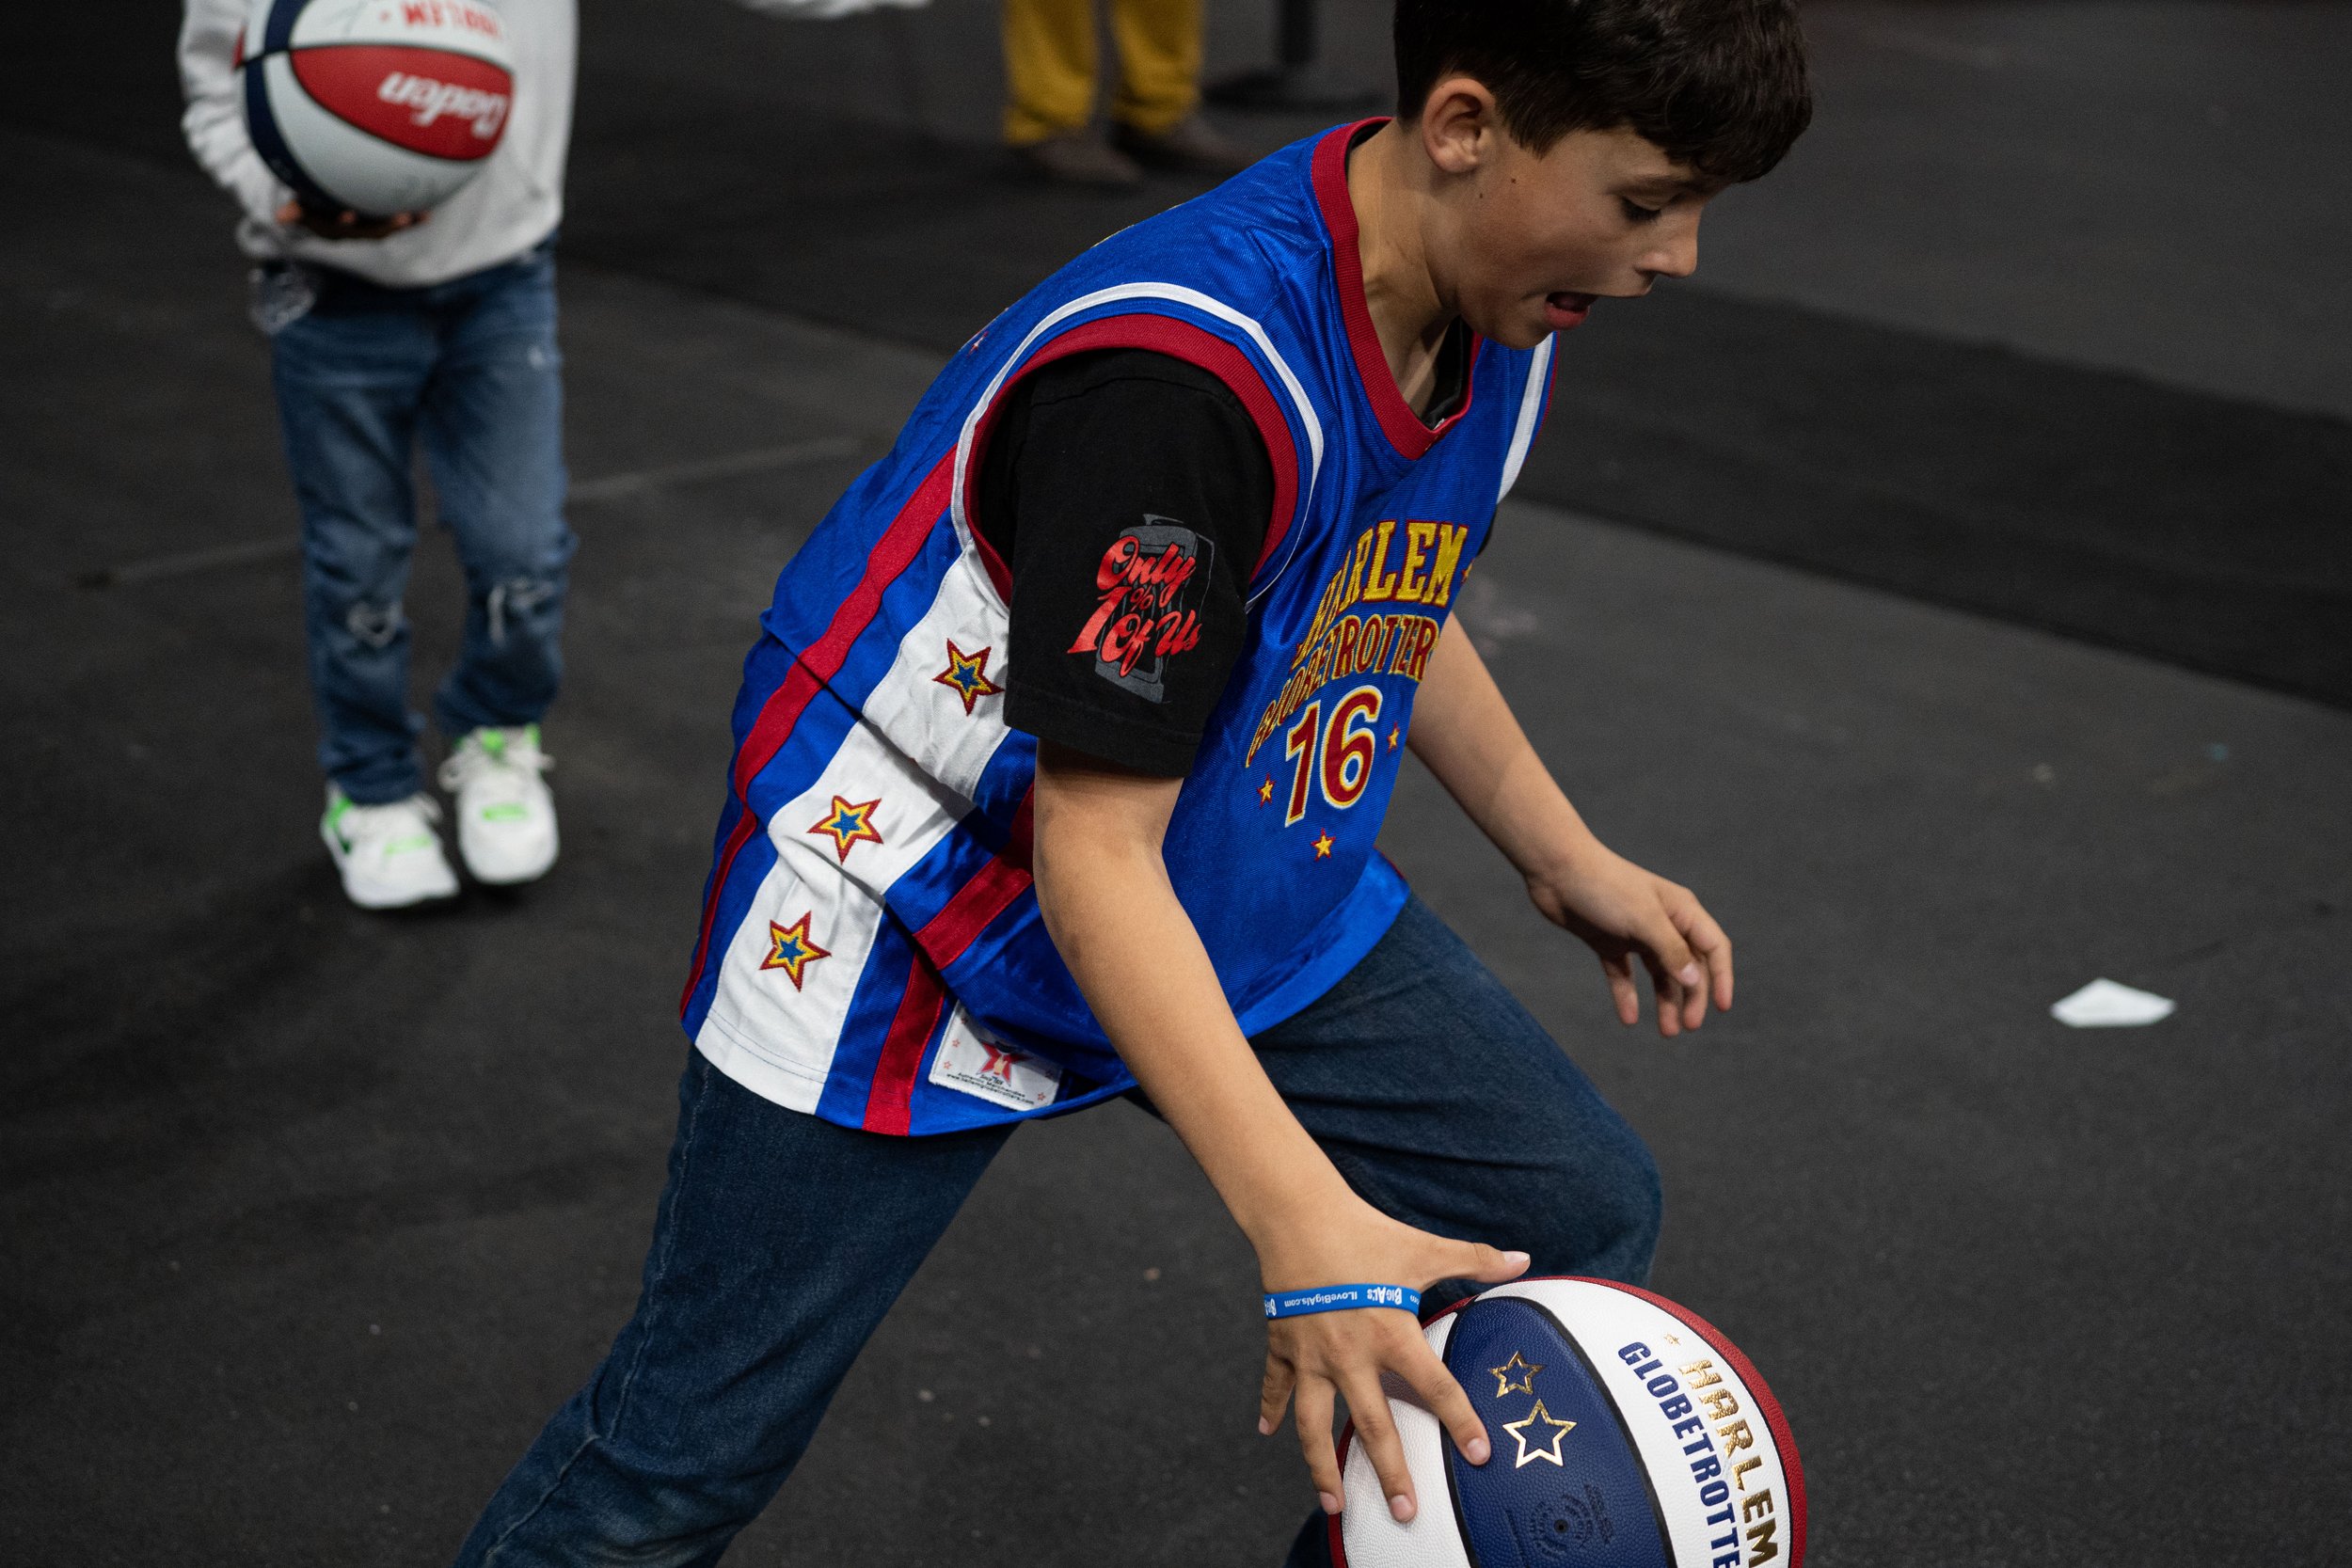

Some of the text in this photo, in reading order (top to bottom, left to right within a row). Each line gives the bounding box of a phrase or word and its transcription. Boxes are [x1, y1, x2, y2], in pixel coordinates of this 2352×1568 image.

[1097, 535, 1196, 608] Only
[1101, 609, 1203, 677] Of Us
[1290, 519, 1470, 673] HARLEM
[1285, 684, 1383, 828] 16
[1678, 1359, 1778, 1568] HARLEM
